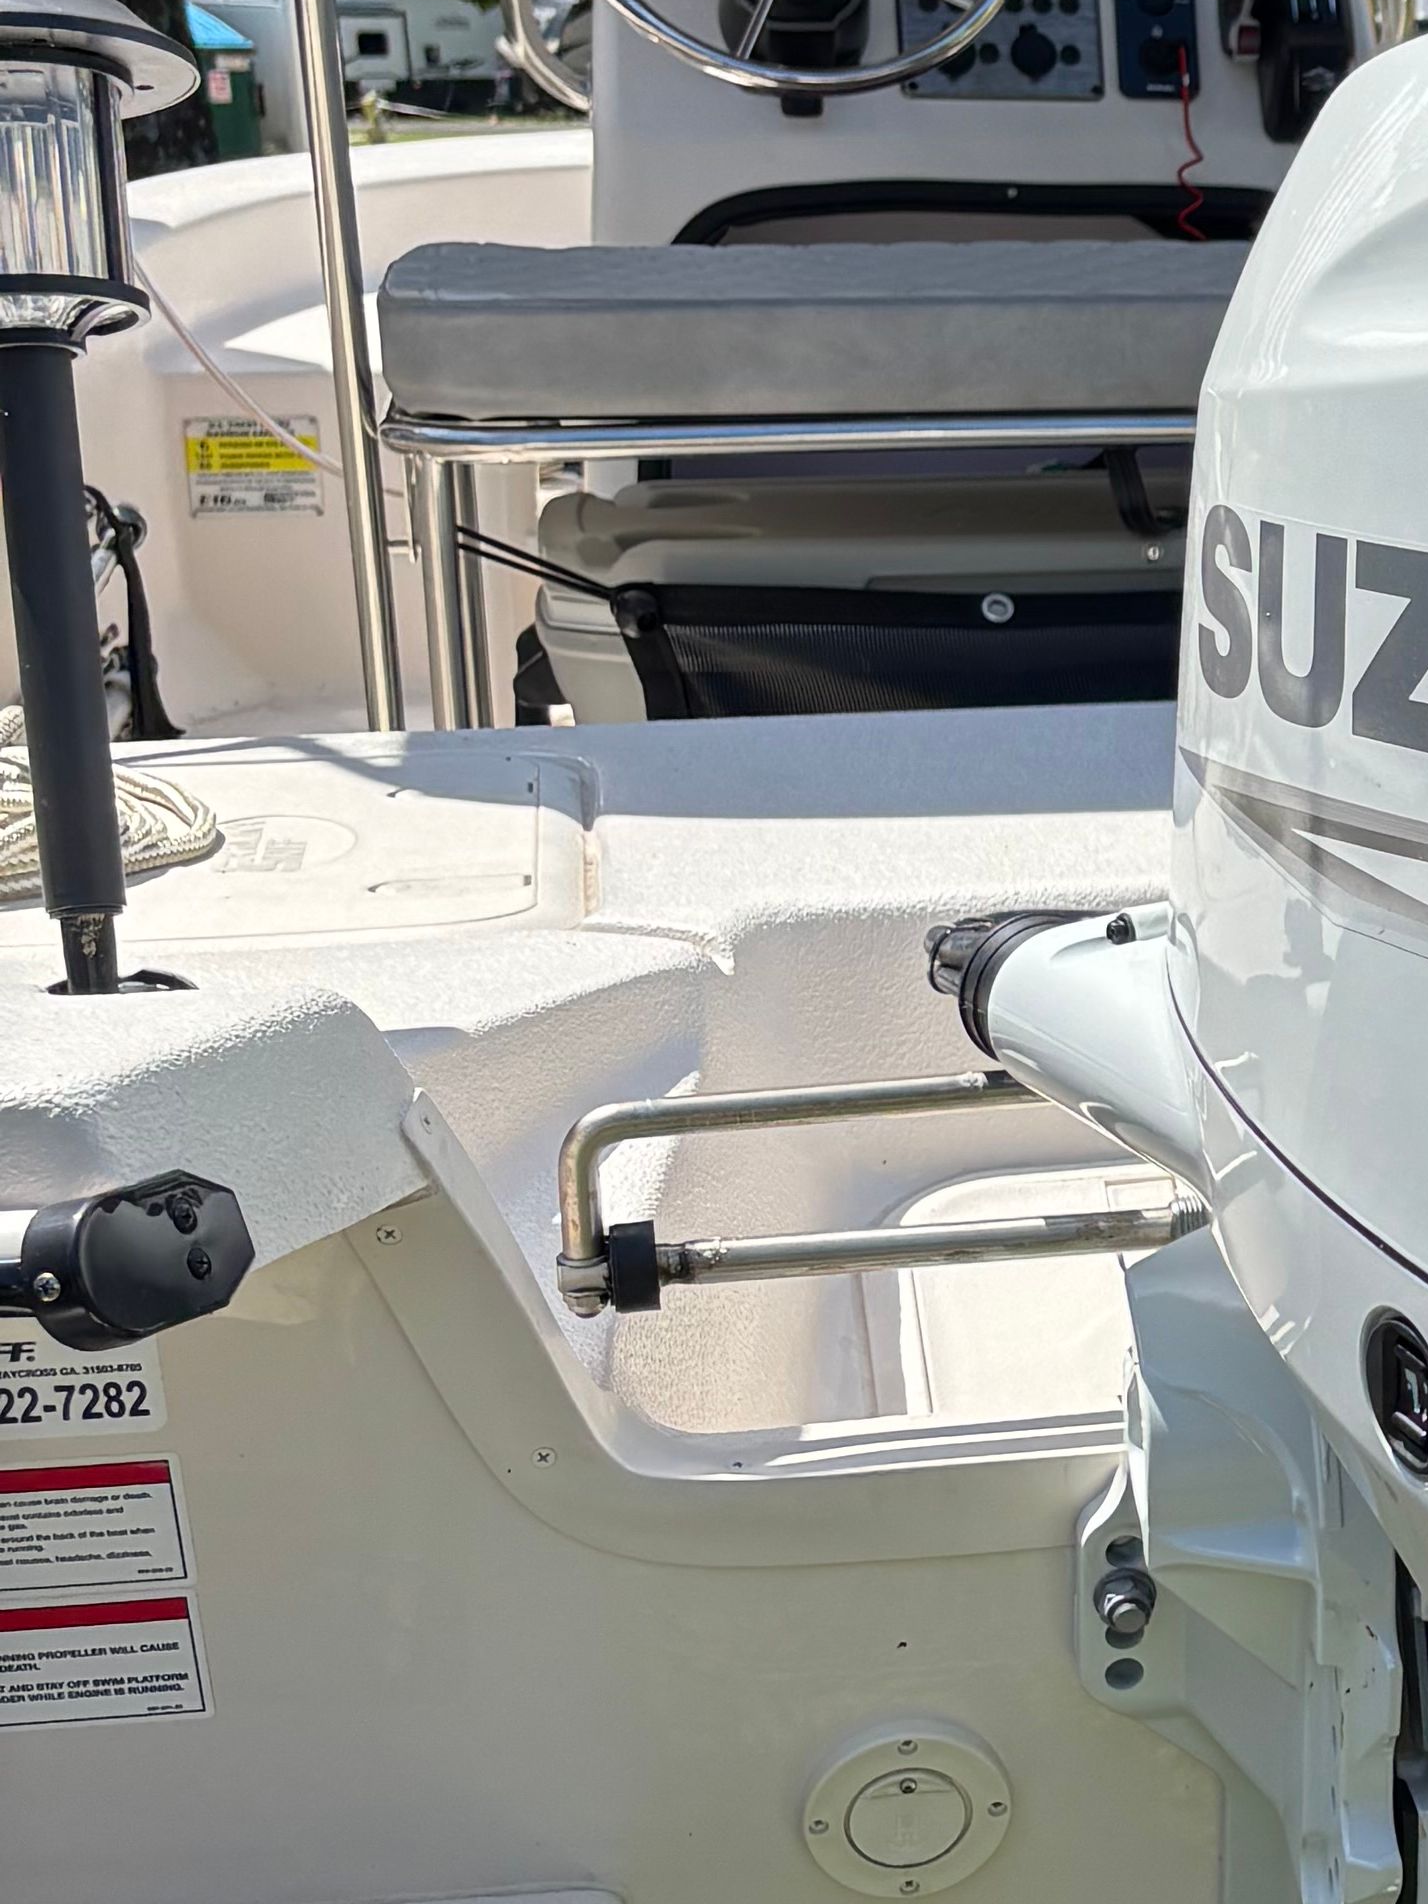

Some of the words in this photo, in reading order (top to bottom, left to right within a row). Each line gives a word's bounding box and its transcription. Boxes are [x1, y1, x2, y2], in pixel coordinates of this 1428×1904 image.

[0, 1379, 150, 1424] 22-7282
[38, 1646, 107, 1660] PROPELLER
[109, 1644, 138, 1655] WILL
[140, 1641, 180, 1653] CAUSE
[8, 1683, 34, 1693] AND
[36, 1681, 65, 1691] STAY
[67, 1679, 90, 1689] OFF
[127, 1672, 189, 1684] PLATFORM
[27, 1691, 65, 1702] WHILE
[67, 1688, 112, 1699] ENGINE
